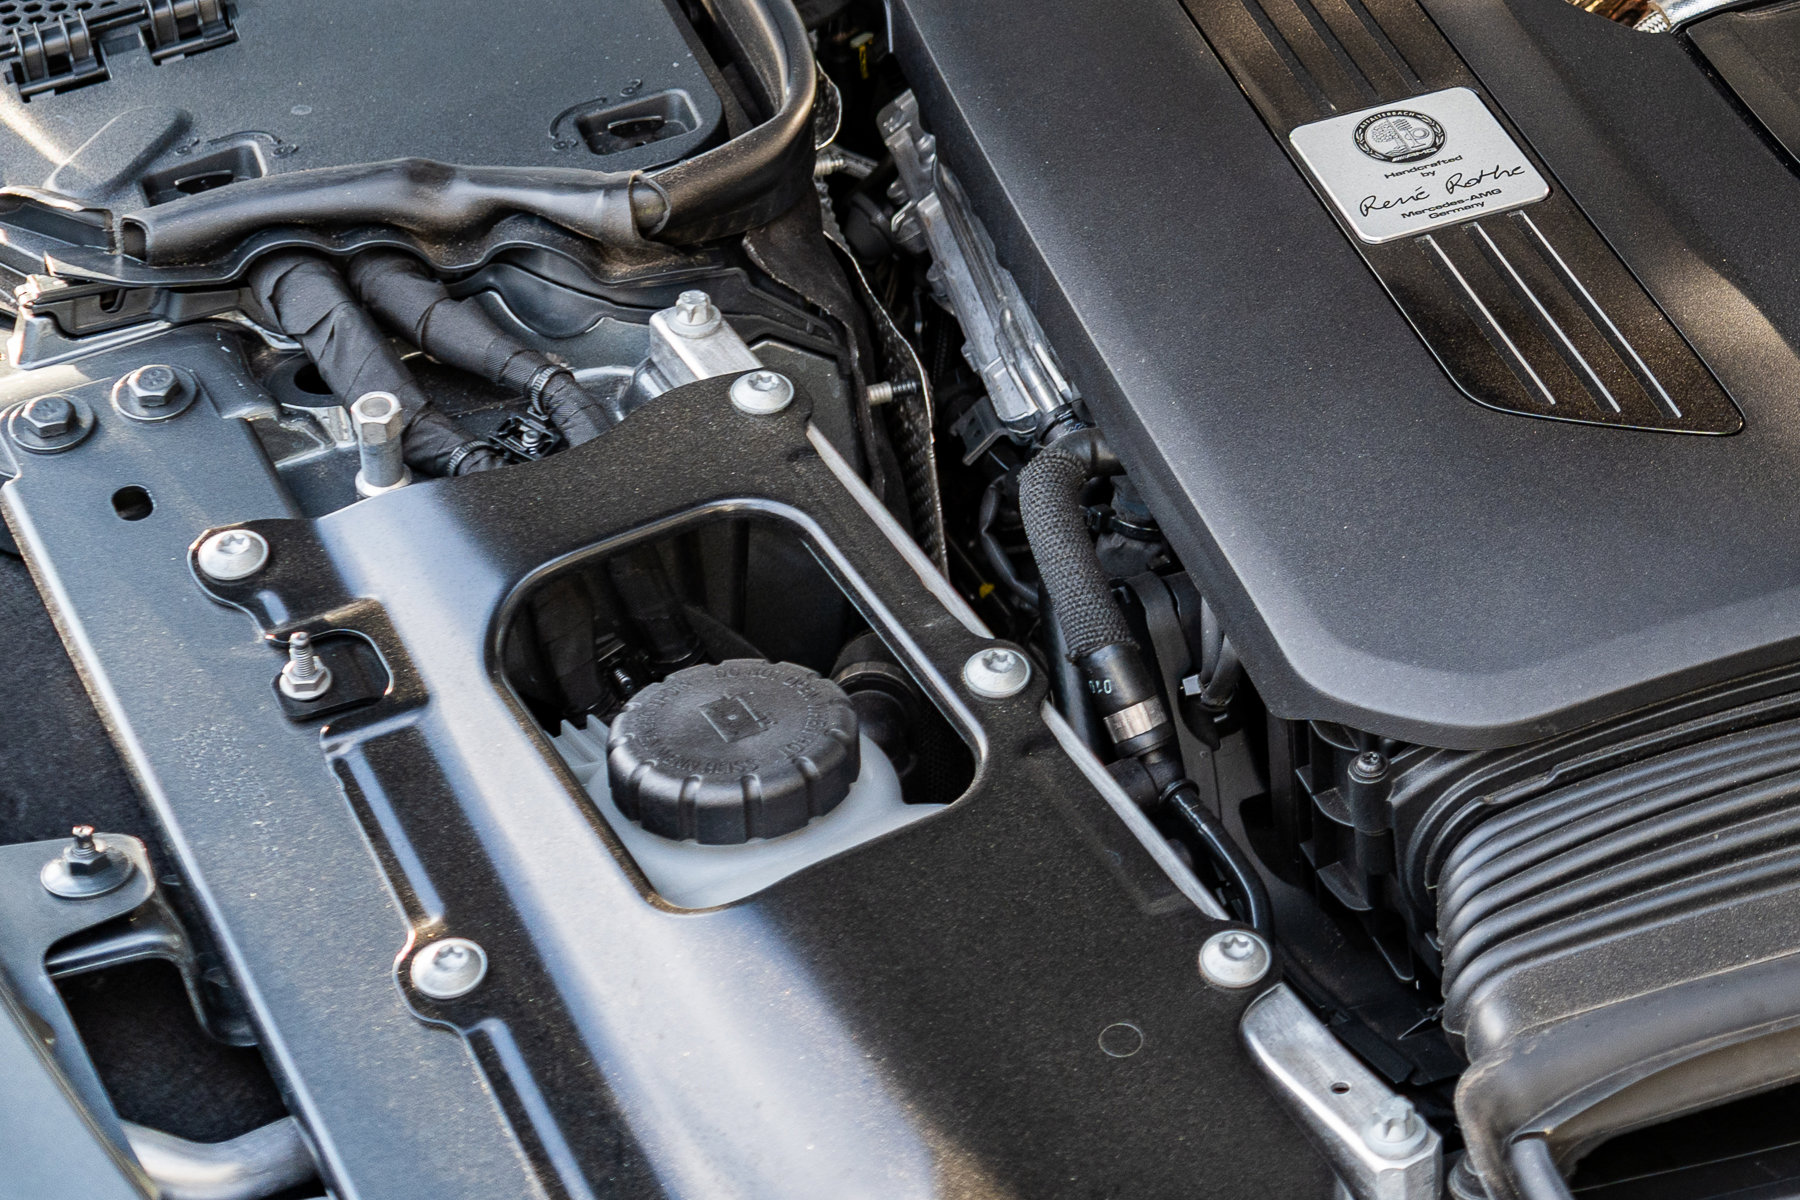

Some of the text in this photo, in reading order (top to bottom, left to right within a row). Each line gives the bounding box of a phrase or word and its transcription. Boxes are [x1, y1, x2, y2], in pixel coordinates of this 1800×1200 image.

[1384, 154, 1463, 179] Handcrafted
[1420, 168, 1436, 179] by
[1400, 187, 1503, 219] Mercedes-AMG
[1428, 200, 1486, 220] Germany
